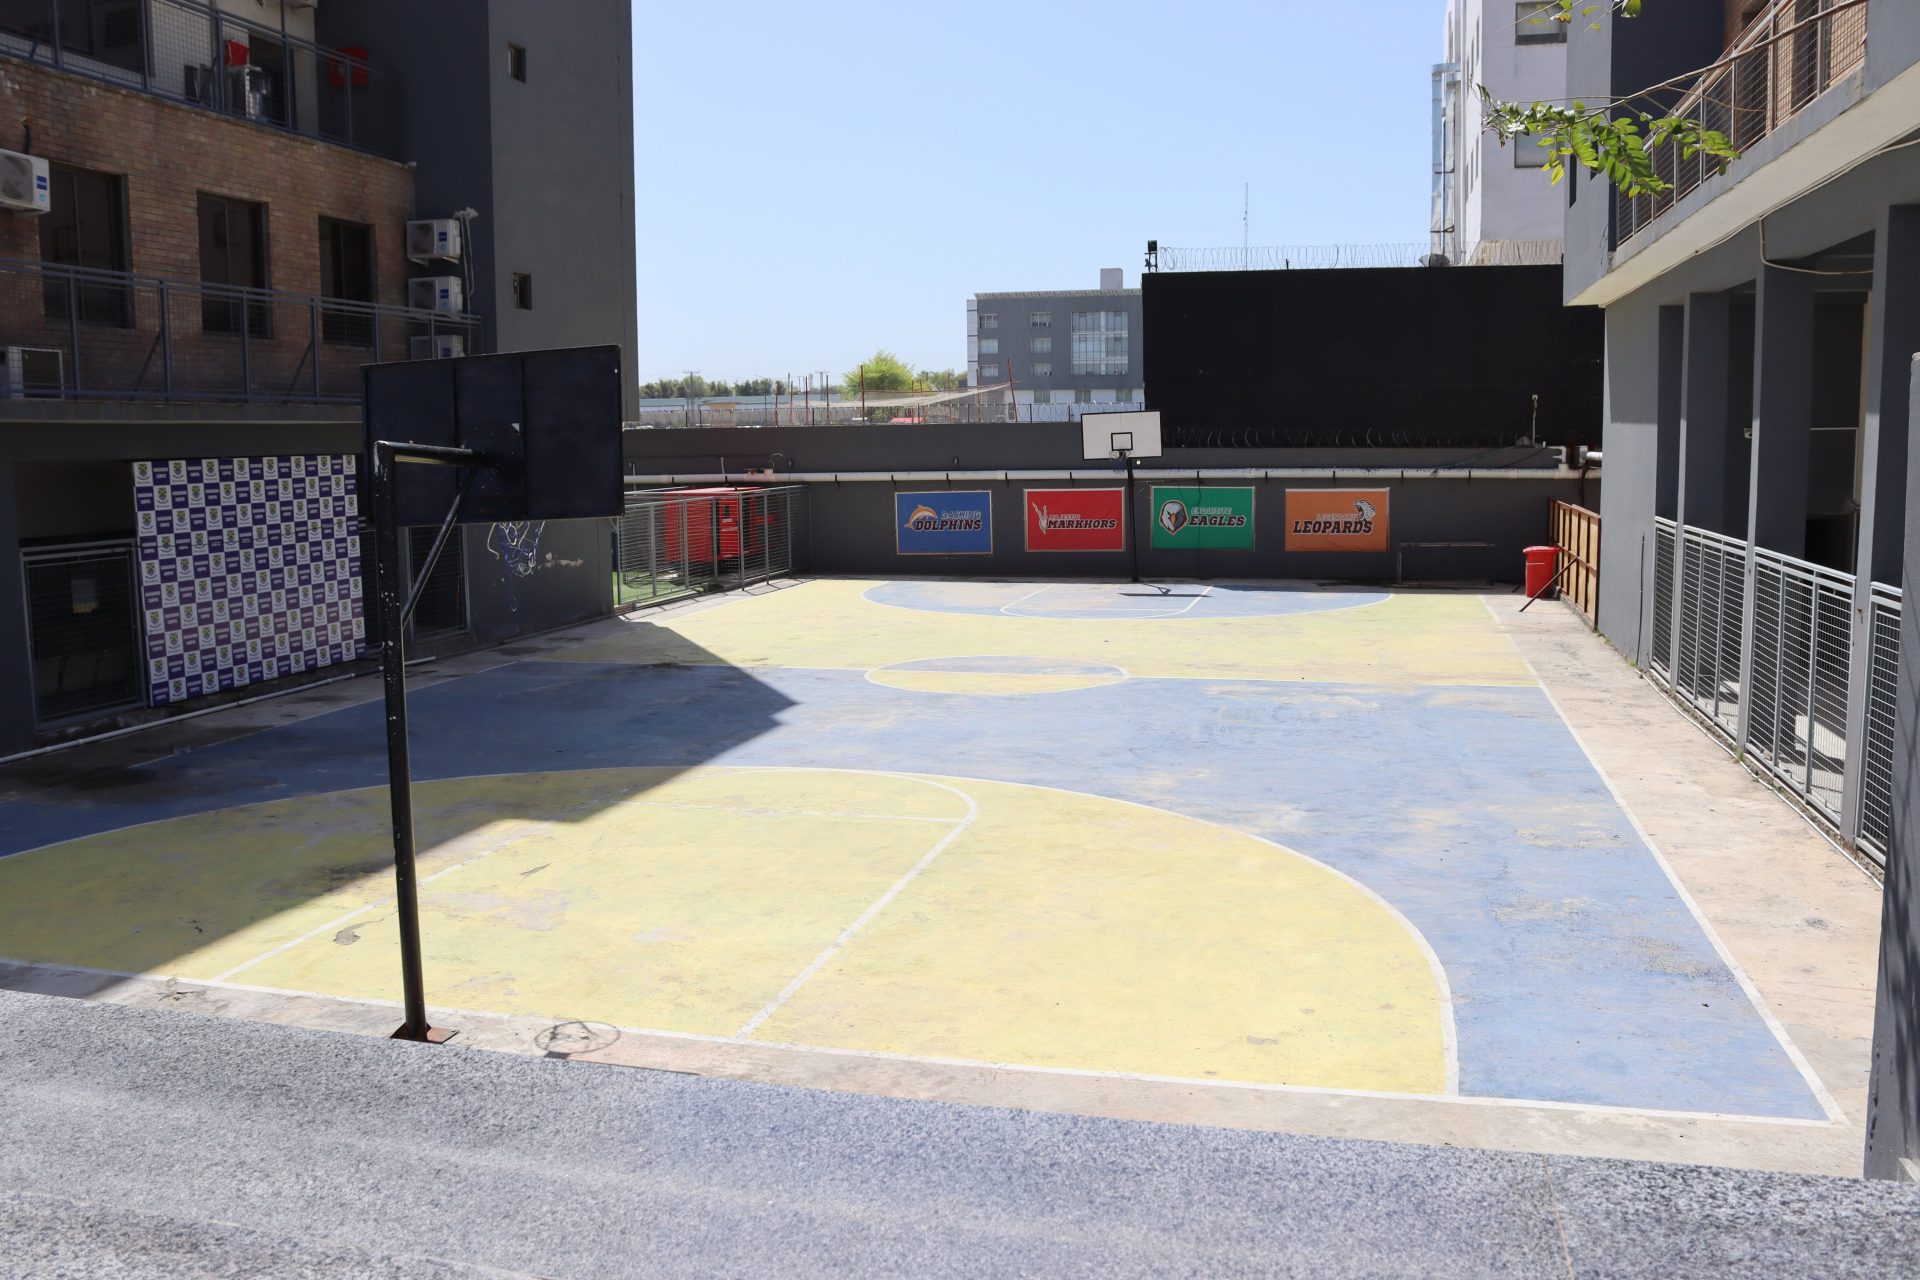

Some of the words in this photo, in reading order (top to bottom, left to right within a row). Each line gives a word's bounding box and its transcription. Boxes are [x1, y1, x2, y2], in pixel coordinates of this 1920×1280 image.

[941, 510, 982, 519] DASHING
[914, 519, 982, 531] DOLPHINS
[1047, 519, 1117, 529] MARKHORS
[1188, 515, 1246, 527] EAGLES
[1292, 520, 1374, 535] LEOPARDS
